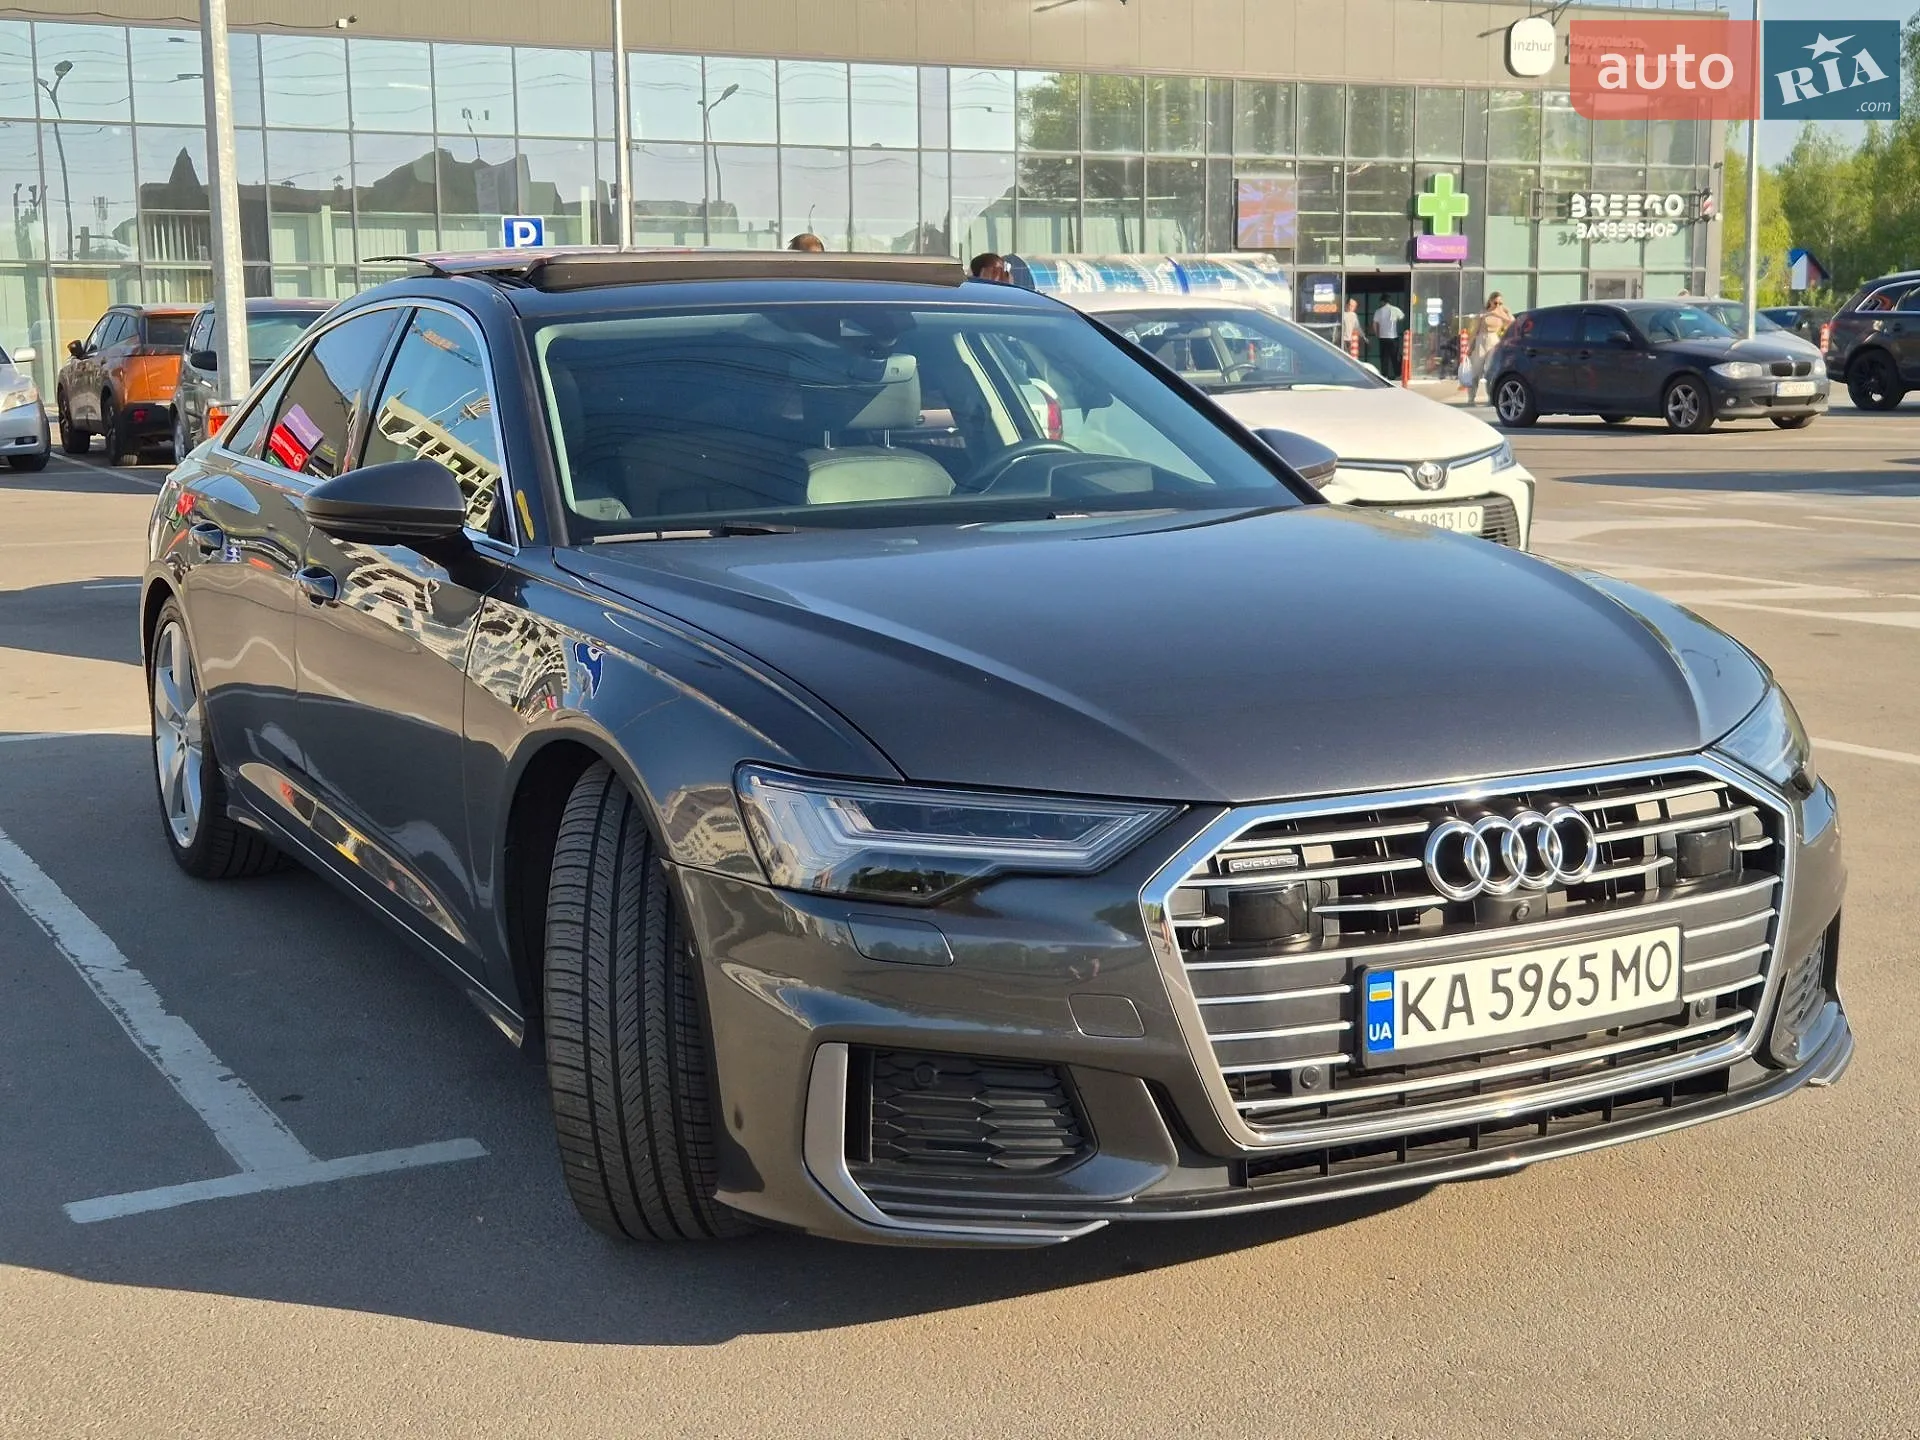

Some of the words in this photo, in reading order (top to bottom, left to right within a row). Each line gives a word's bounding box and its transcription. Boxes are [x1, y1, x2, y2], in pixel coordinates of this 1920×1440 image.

[1513, 38, 1553, 52] inzhur
[513, 221, 537, 247] P
[1576, 222, 1678, 240] BARBERSHOP
[1232, 857, 1296, 869] quattro
[1401, 973, 1475, 1036] KA
[1488, 952, 1600, 1021] 5965
[1610, 940, 1672, 1001] MO
[1369, 1022, 1393, 1042] UA
